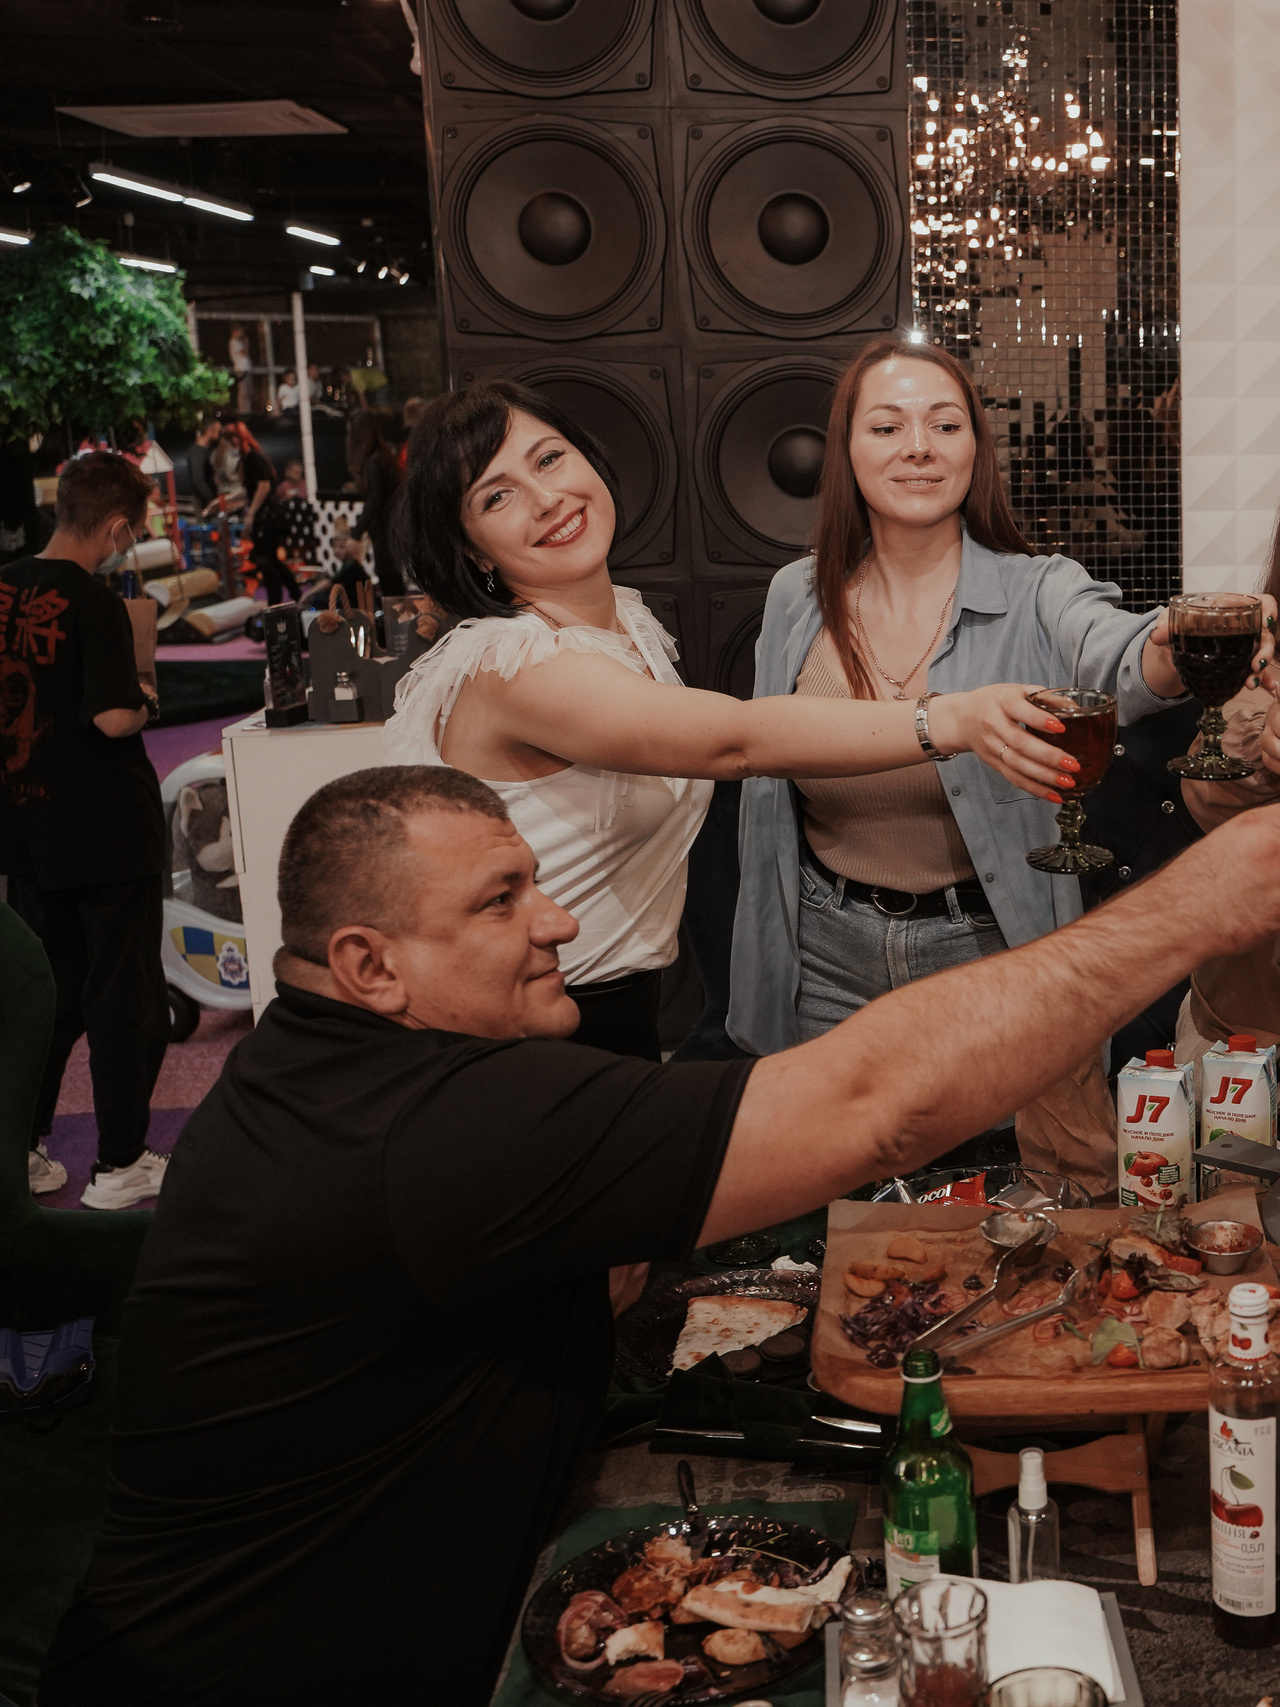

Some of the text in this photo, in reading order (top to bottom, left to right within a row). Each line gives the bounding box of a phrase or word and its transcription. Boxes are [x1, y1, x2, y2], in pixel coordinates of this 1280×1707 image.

[1210, 1076, 1253, 1104] J7
[1126, 1095, 1170, 1123] J7
[1122, 1128, 1143, 1136] ВКУСНОЕ
